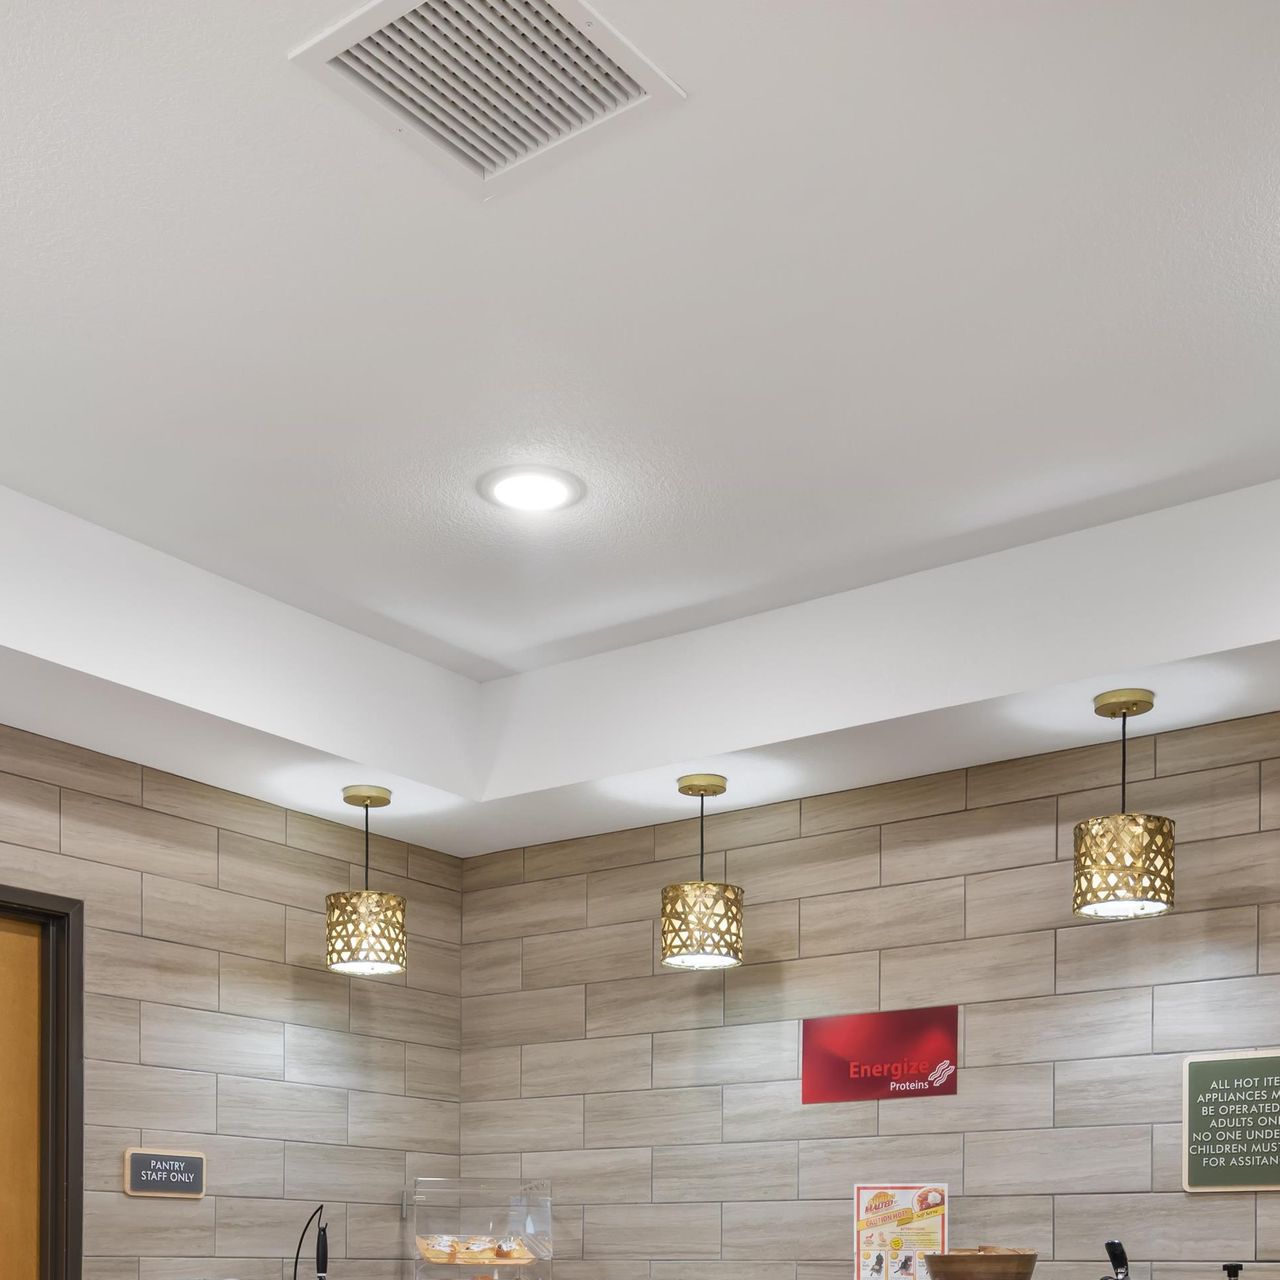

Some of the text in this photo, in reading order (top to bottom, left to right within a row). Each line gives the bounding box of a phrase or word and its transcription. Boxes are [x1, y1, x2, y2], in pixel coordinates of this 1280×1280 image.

[849, 1058, 929, 1079] Energize
[890, 1080, 929, 1091] Proteins
[1210, 1080, 1230, 1090] ALL
[1234, 1078, 1260, 1089] HOT
[1197, 1090, 1267, 1103] APPLIANCES
[1202, 1106, 1215, 1116] BE
[1219, 1103, 1280, 1115] OPERATED
[1210, 1117, 1254, 1128] ADULTS
[1192, 1132, 1212, 1142] NO
[1216, 1130, 1242, 1141] ONE
[1189, 1143, 1247, 1155] CHILDREN
[150, 1160, 185, 1171] PANTRY
[1202, 1157, 1226, 1167] FOR
[141, 1171, 194, 1182] STAFF ONLY
